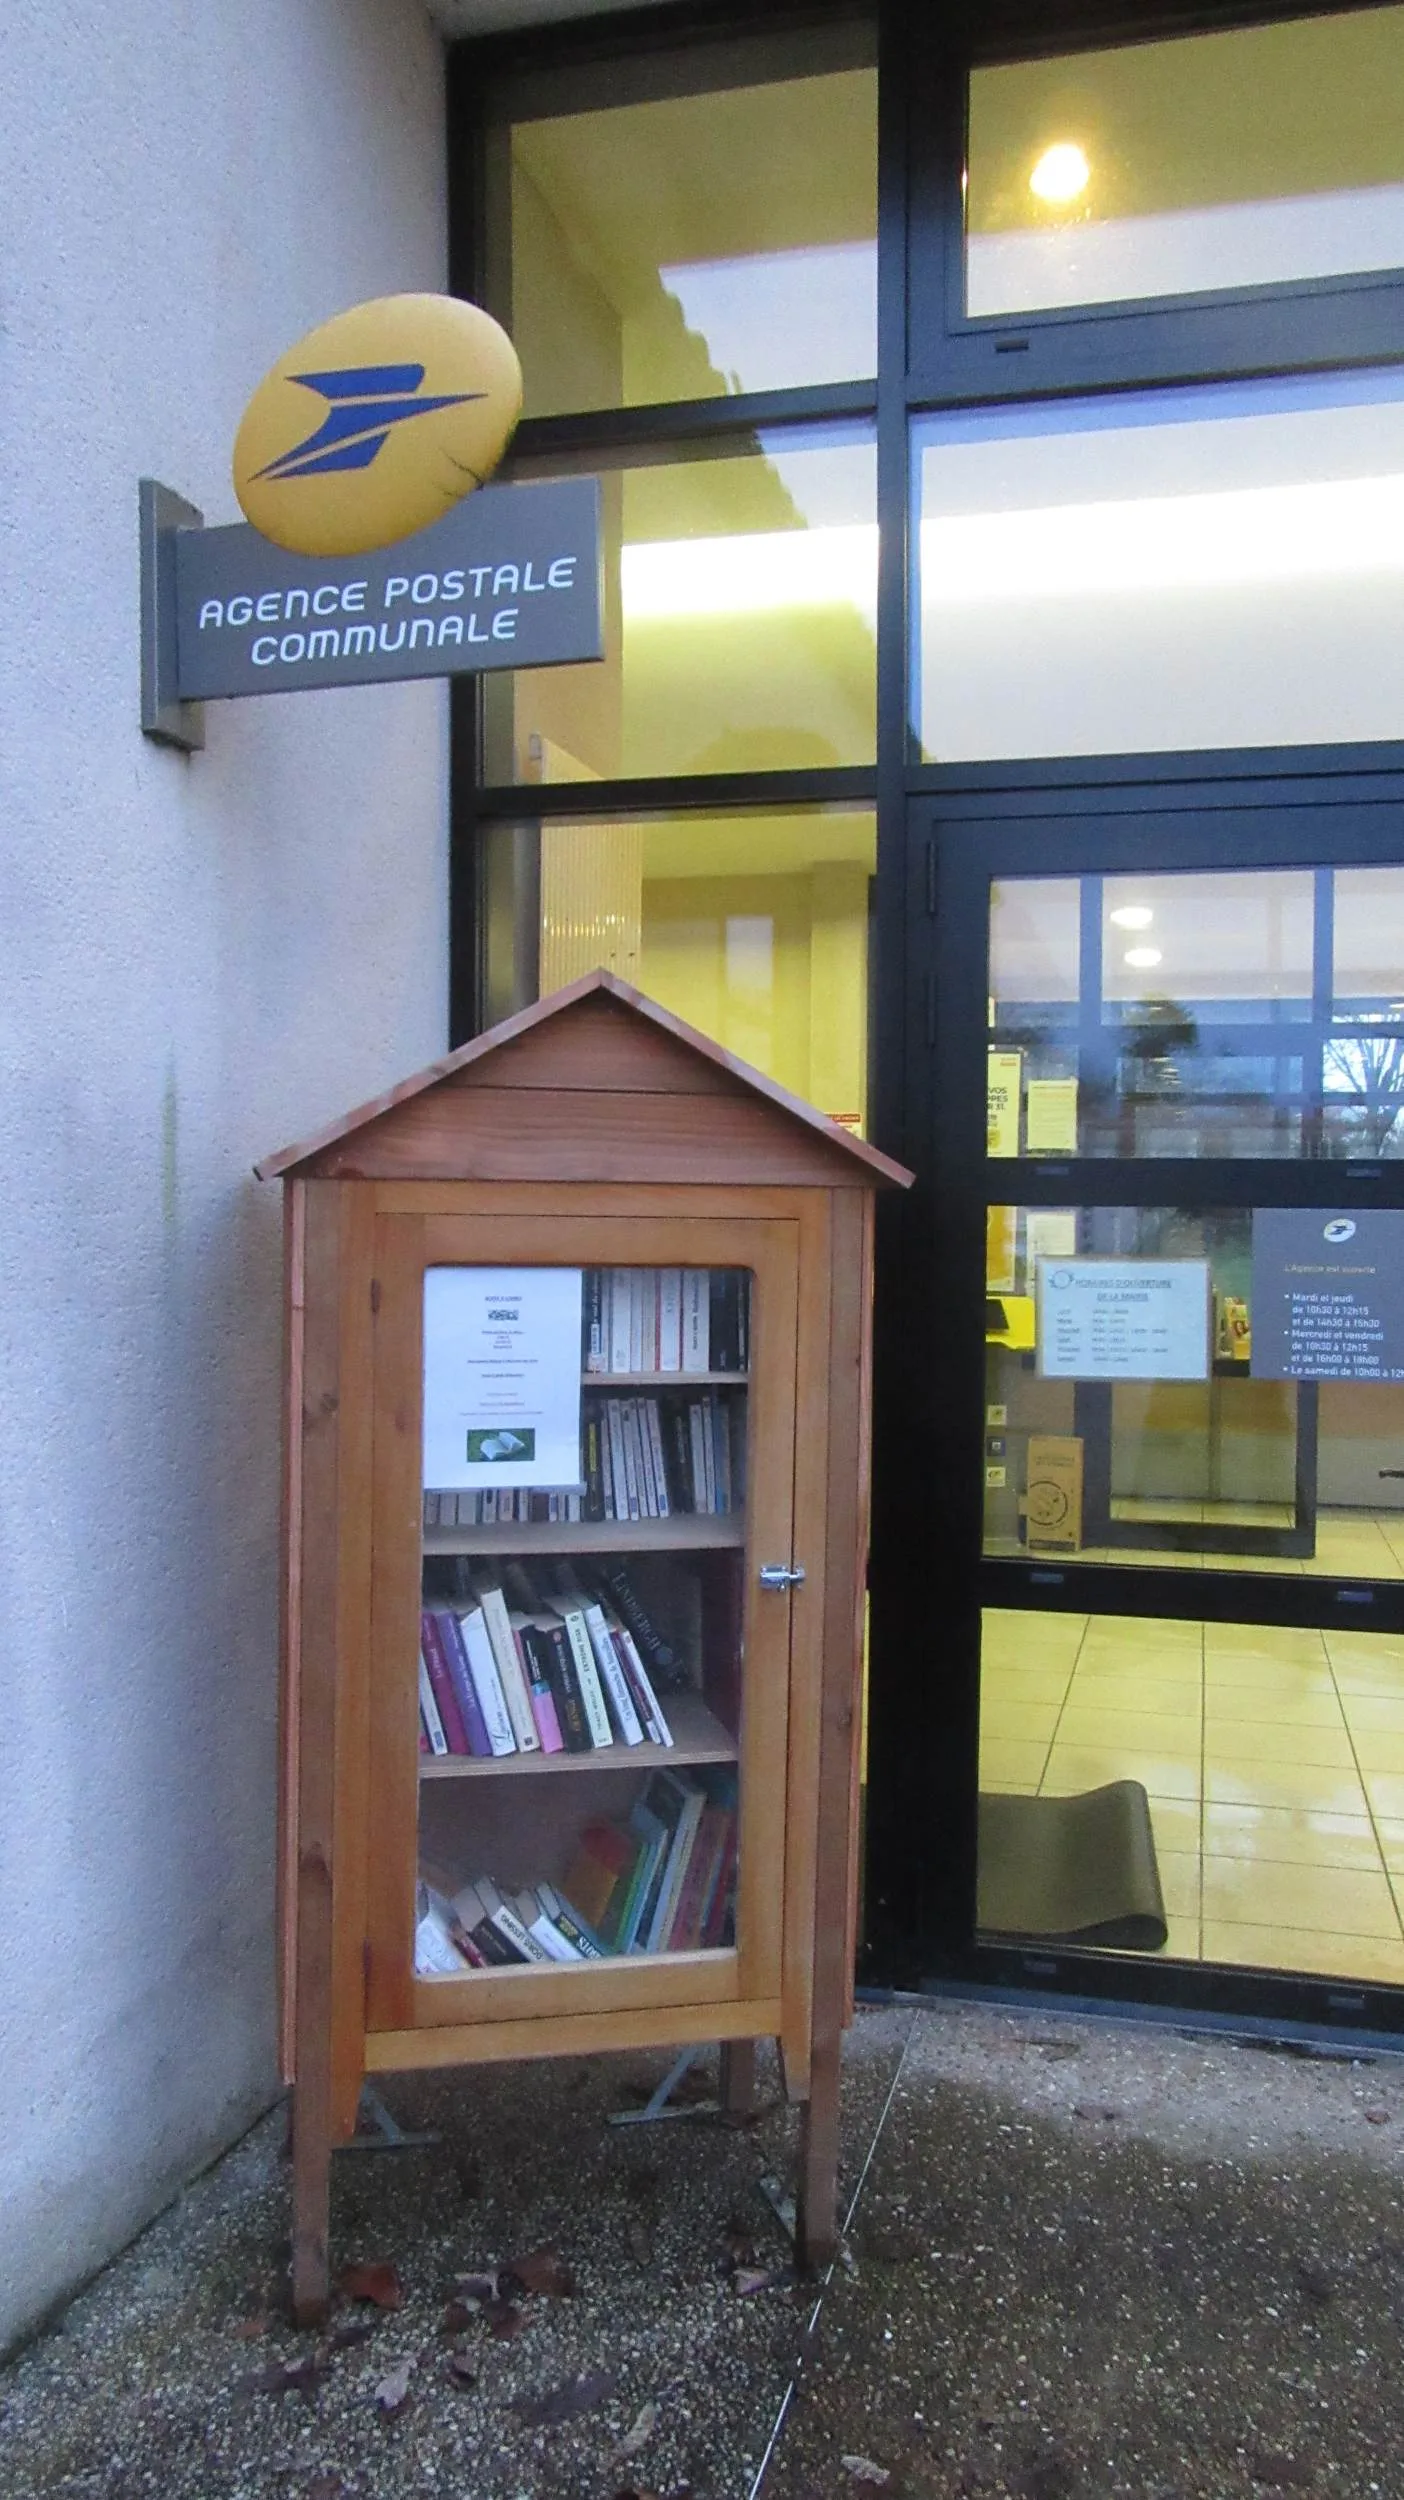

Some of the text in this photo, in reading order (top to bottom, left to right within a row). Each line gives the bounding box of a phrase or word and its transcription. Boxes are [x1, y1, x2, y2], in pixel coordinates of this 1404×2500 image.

[200, 556, 577, 629] AGENCE POSTALE
[250, 608, 520, 666] COMMUNALE
[1292, 1293, 1318, 1302] Mardi
[1331, 1294, 1354, 1304] jeudi
[1291, 1329, 1332, 1339] Mercredi
[1344, 1331, 1384, 1341] vendredi
[1290, 1366, 1302, 1375] Le
[1304, 1366, 1339, 1376] samedi
[501, 1915, 530, 1942] LESSING
